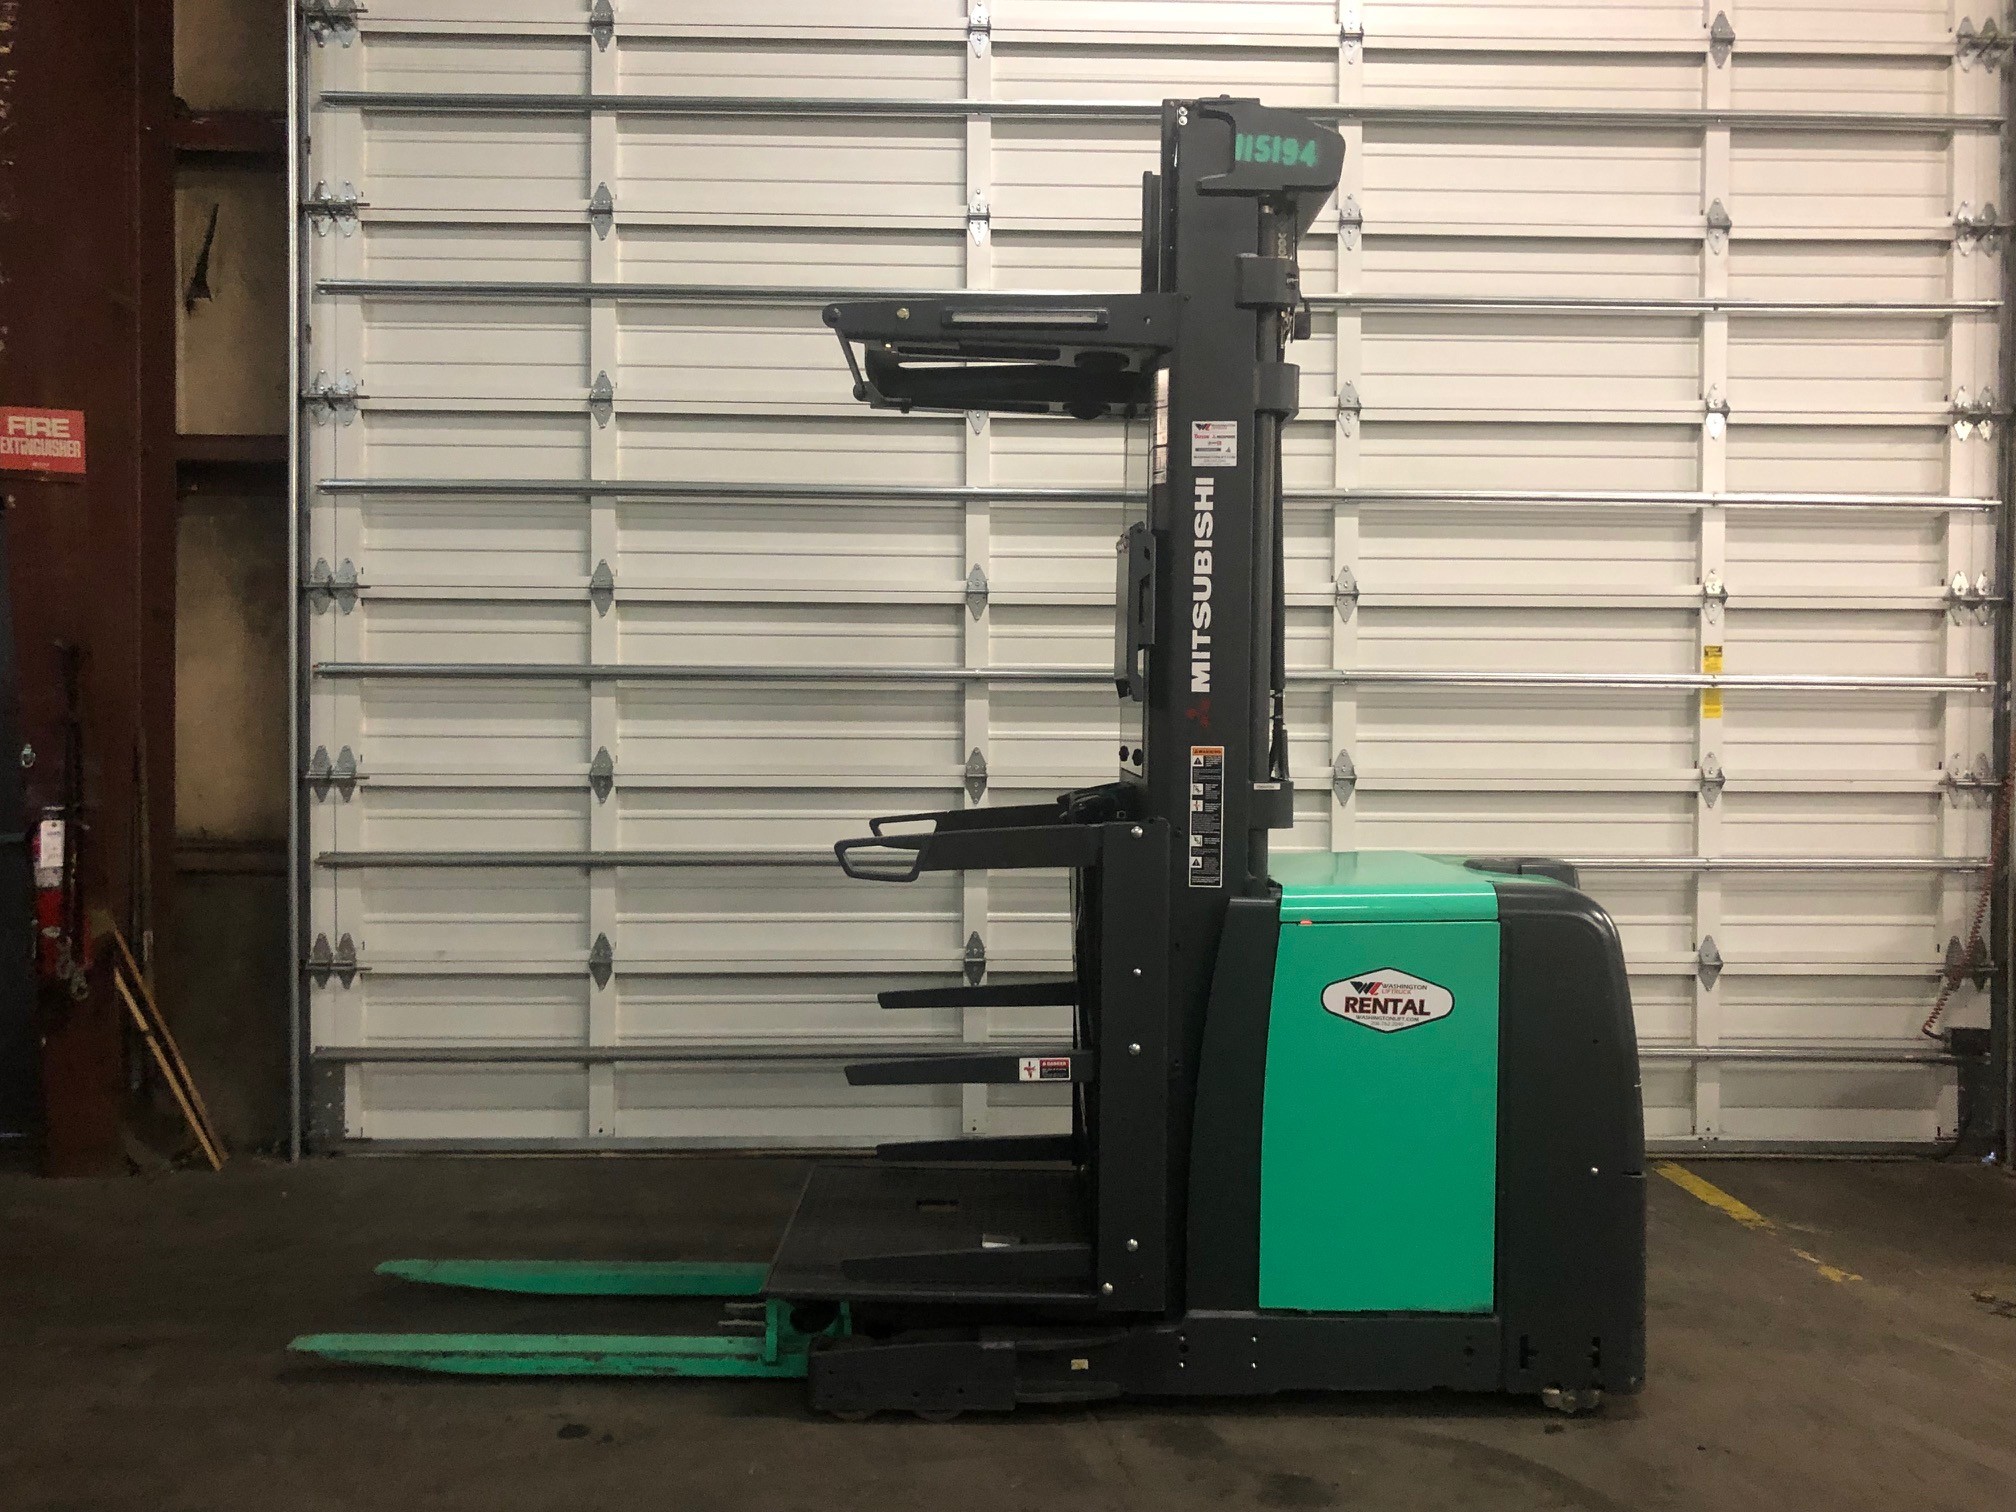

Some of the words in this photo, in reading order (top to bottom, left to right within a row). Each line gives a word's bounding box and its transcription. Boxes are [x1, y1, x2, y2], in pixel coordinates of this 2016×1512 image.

[1235, 133, 1319, 167] 115194
[8, 415, 71, 438] FIRE
[0, 436, 82, 458] EXTINGUISHER
[1191, 477, 1215, 692] MITSUBISHI
[1382, 983, 1428, 991] WASHINGTON
[1344, 996, 1431, 1016] RENTAL
